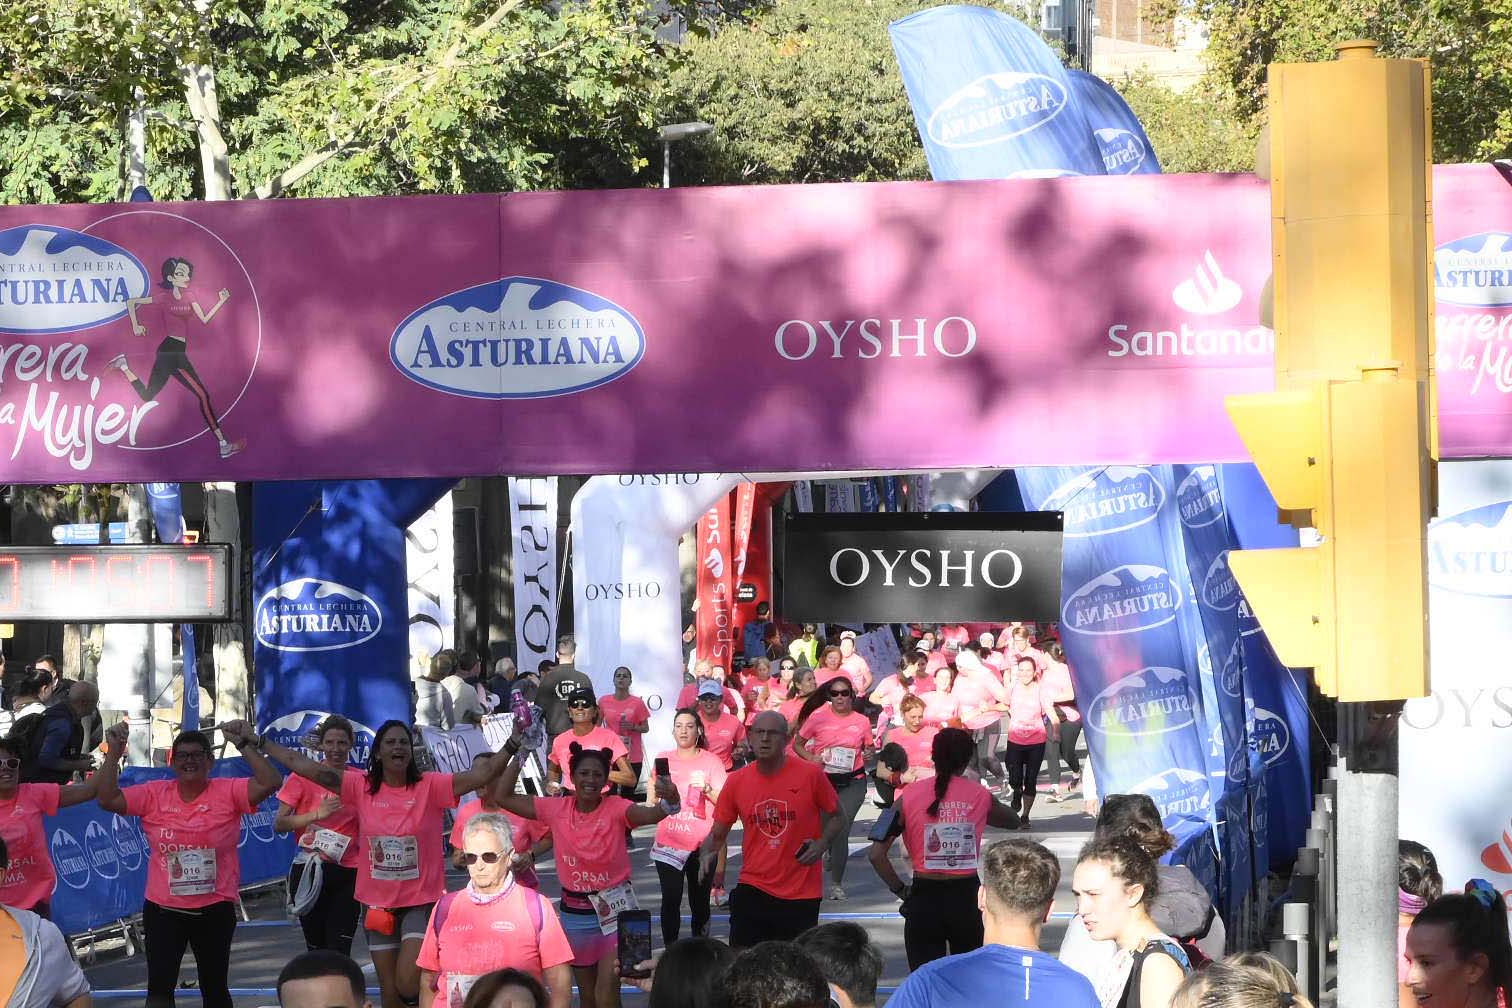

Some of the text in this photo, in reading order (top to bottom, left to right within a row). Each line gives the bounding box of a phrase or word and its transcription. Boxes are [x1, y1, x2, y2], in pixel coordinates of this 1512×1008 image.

[52, 261, 125, 272] LECHERA
[449, 318, 617, 333] CENTRAL LECHERA
[409, 325, 626, 369] ASTURIANA
[774, 316, 977, 361] OYSHO
[10, 377, 160, 471] Mujer
[829, 546, 1023, 590] OYSHO
[585, 581, 661, 601] OYSHO
[272, 603, 315, 612] CENTRAL
[259, 606, 373, 633] ASTURIANA
[713, 583, 731, 657] Sports
[938, 801, 973, 810] ARRERA
[940, 809, 967, 817] DE LA
[668, 823, 691, 832] UMA
[7, 856, 37, 869] RSAL
